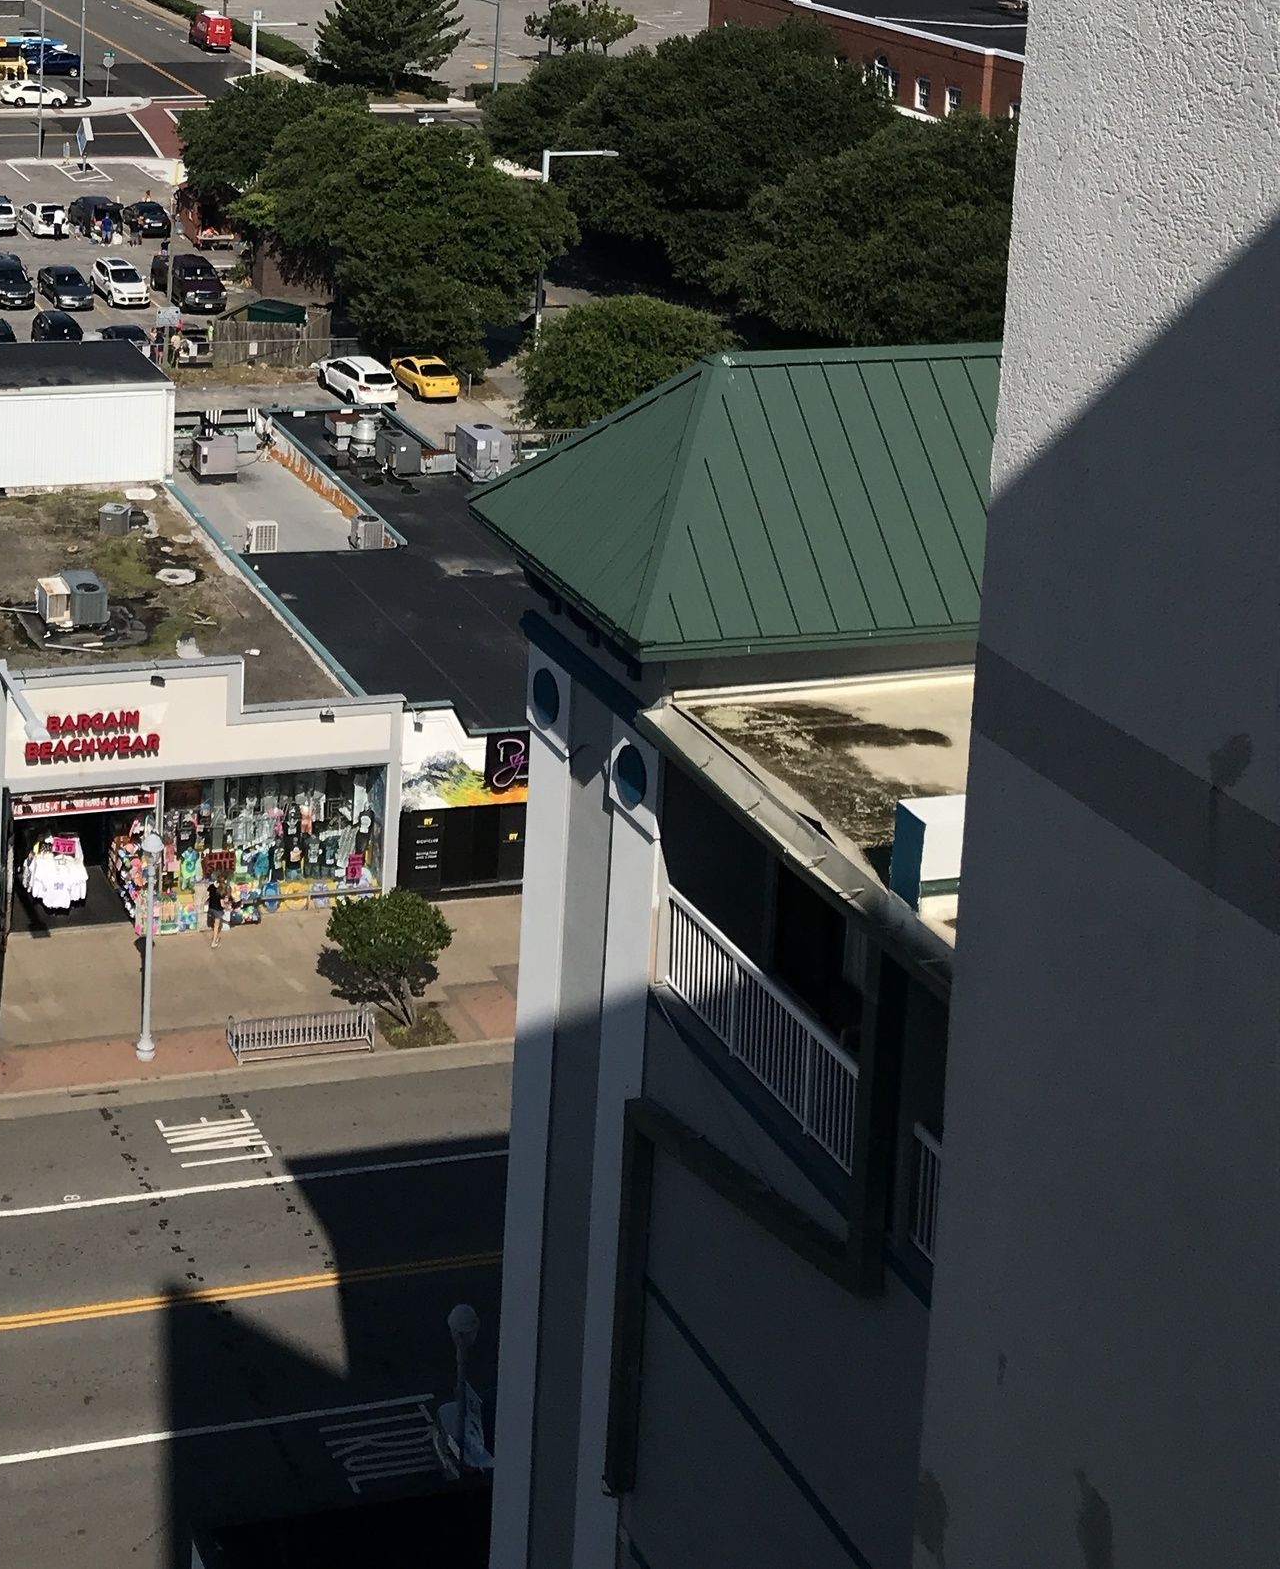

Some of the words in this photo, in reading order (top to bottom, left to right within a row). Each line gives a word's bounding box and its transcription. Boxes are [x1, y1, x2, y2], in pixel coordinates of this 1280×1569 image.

[46, 710, 140, 733] BARGAIN
[25, 733, 161, 760] BEACHWEAR
[208, 860, 235, 872] SALE
[154, 1109, 274, 1169] LANE
